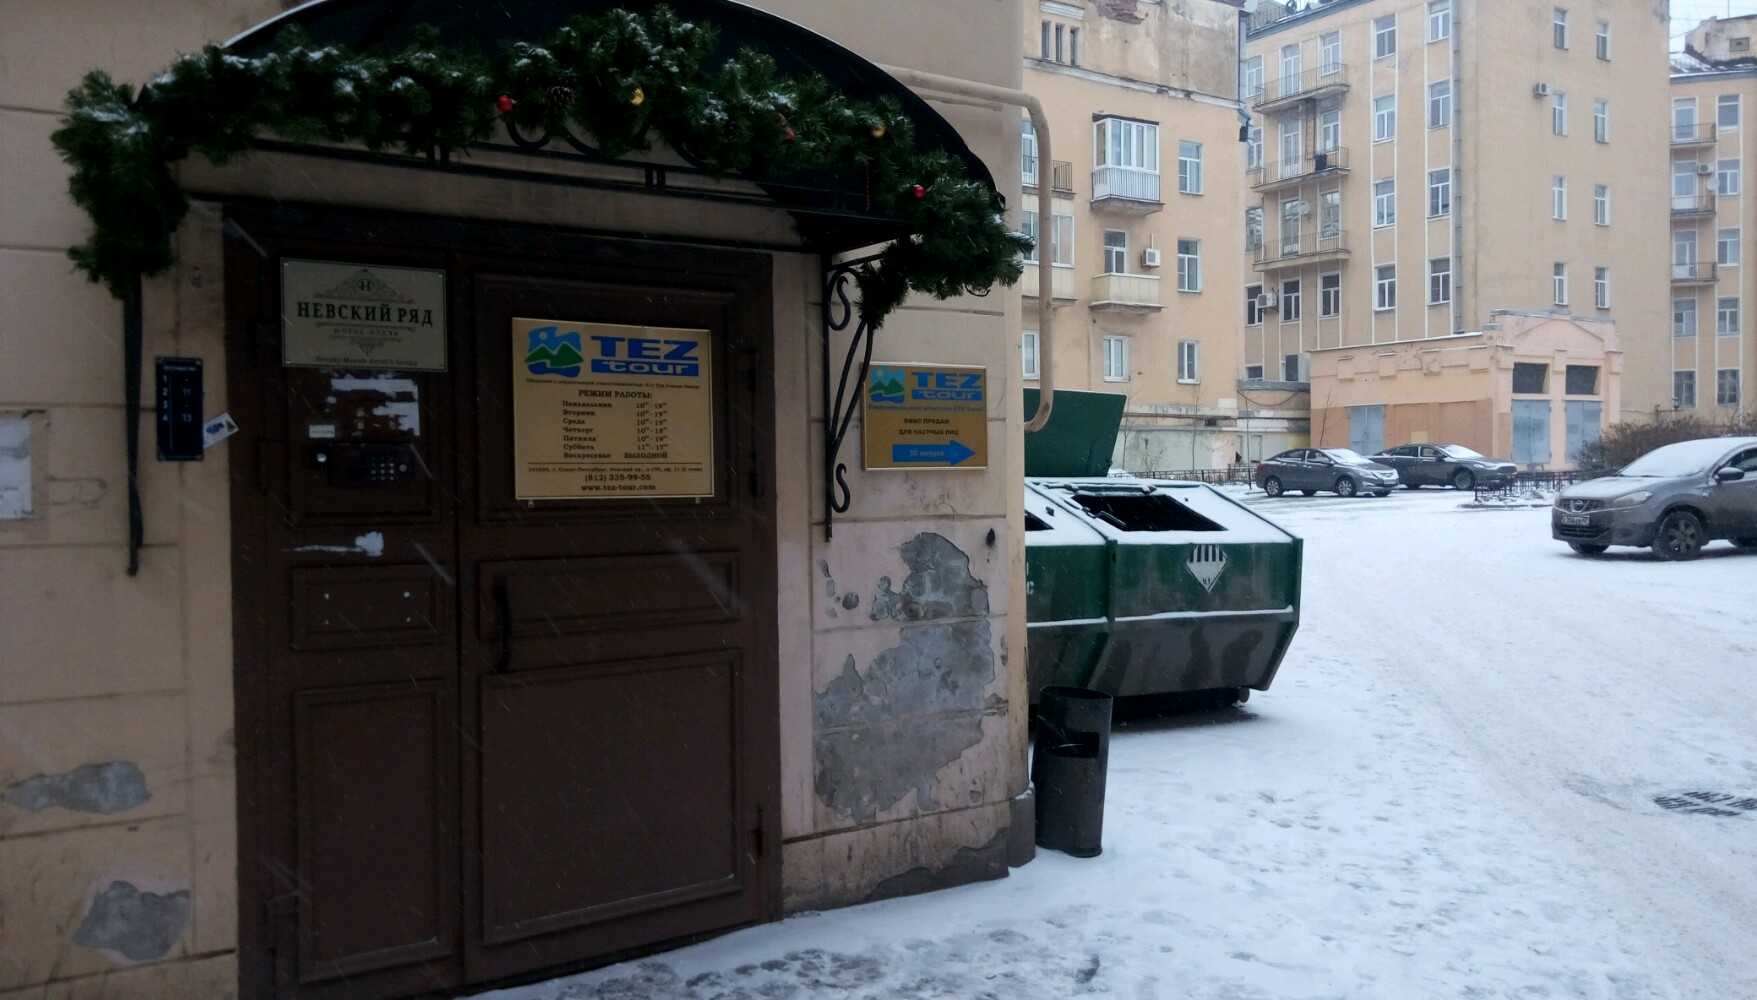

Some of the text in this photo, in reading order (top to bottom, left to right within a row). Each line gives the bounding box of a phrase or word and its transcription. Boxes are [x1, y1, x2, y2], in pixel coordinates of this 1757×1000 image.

[297, 302, 433, 328] НЕВСКИЙ РЯД
[590, 335, 699, 362] TEZ
[602, 360, 689, 375] tour
[911, 371, 983, 389] TEZ
[162, 387, 191, 397] 2 11
[578, 389, 653, 400] РЕЖИМ РАБОТЫ:
[919, 390, 976, 400] tour
[162, 400, 168, 409] 3
[162, 413, 169, 422] 4
[562, 418, 586, 426] Среда
[923, 418, 950, 426] ПРОДАЖ
[563, 426, 594, 434] Четверг
[945, 429, 959, 437] ЛИЦ
[563, 443, 595, 452] Суббота
[563, 450, 668, 461] Воскресенье ВЫХОДНОЙ
[584, 473, 652, 483] (812) 335-99-55
[581, 483, 656, 491] www.tez-tour.com
